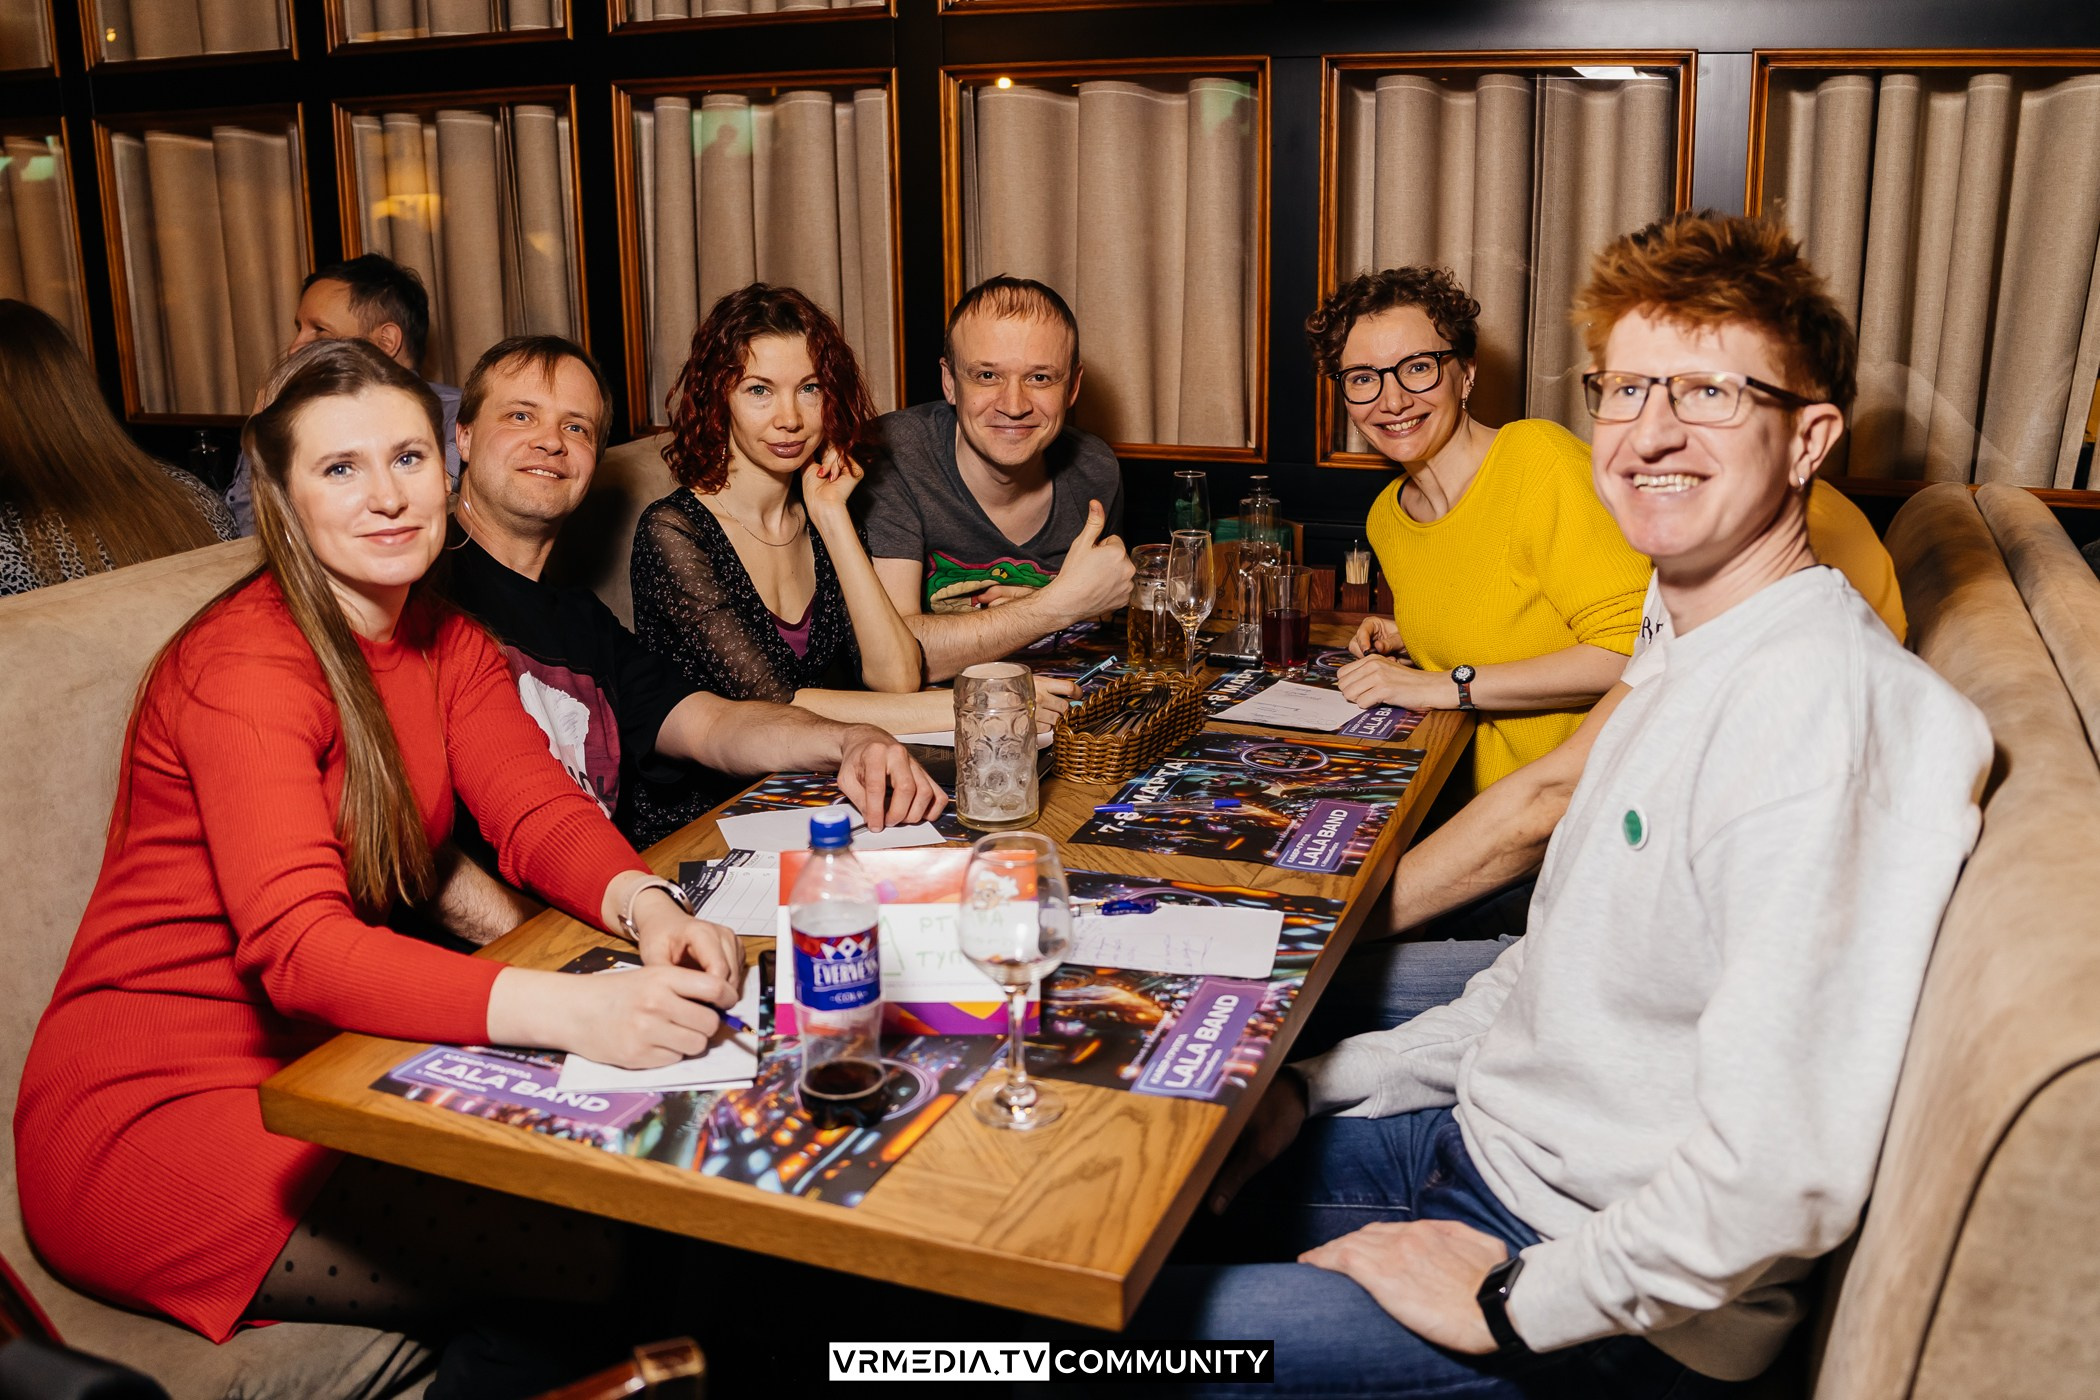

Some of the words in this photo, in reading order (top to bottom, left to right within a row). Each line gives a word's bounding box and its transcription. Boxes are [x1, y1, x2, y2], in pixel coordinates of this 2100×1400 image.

[1358, 716, 1387, 735] LALA
[1098, 811, 1143, 833] 7-8
[1127, 761, 1189, 804] МАРТА
[1298, 839, 1332, 866] LALA
[1316, 809, 1348, 839] BAND
[1164, 1043, 1213, 1088] LALA
[1194, 994, 1240, 1042] BAND
[424, 1058, 507, 1090] LALA
[509, 1079, 611, 1112] BAND
